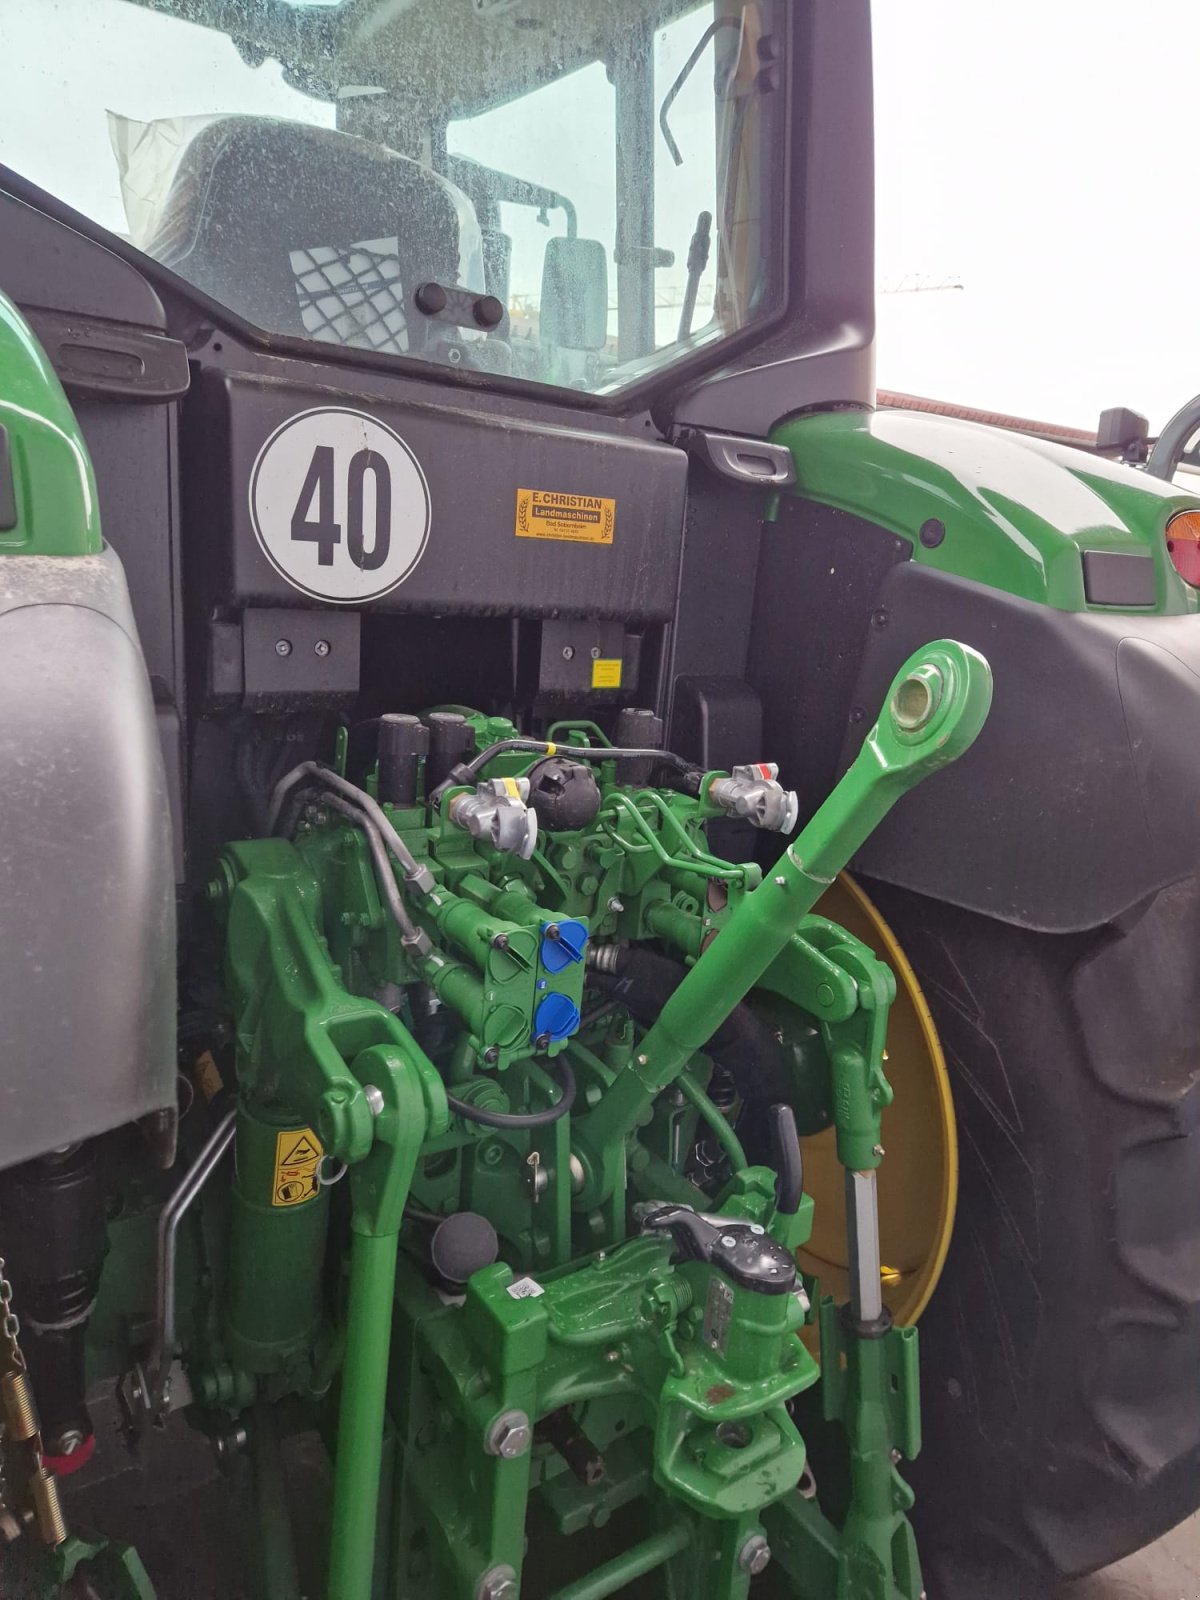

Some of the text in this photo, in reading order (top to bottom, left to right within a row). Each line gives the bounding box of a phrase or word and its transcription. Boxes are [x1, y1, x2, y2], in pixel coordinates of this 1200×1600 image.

[290, 445, 392, 571] 40
[543, 493, 602, 509] CHRISTIAN
[535, 507, 598, 521] Landmaschinen
